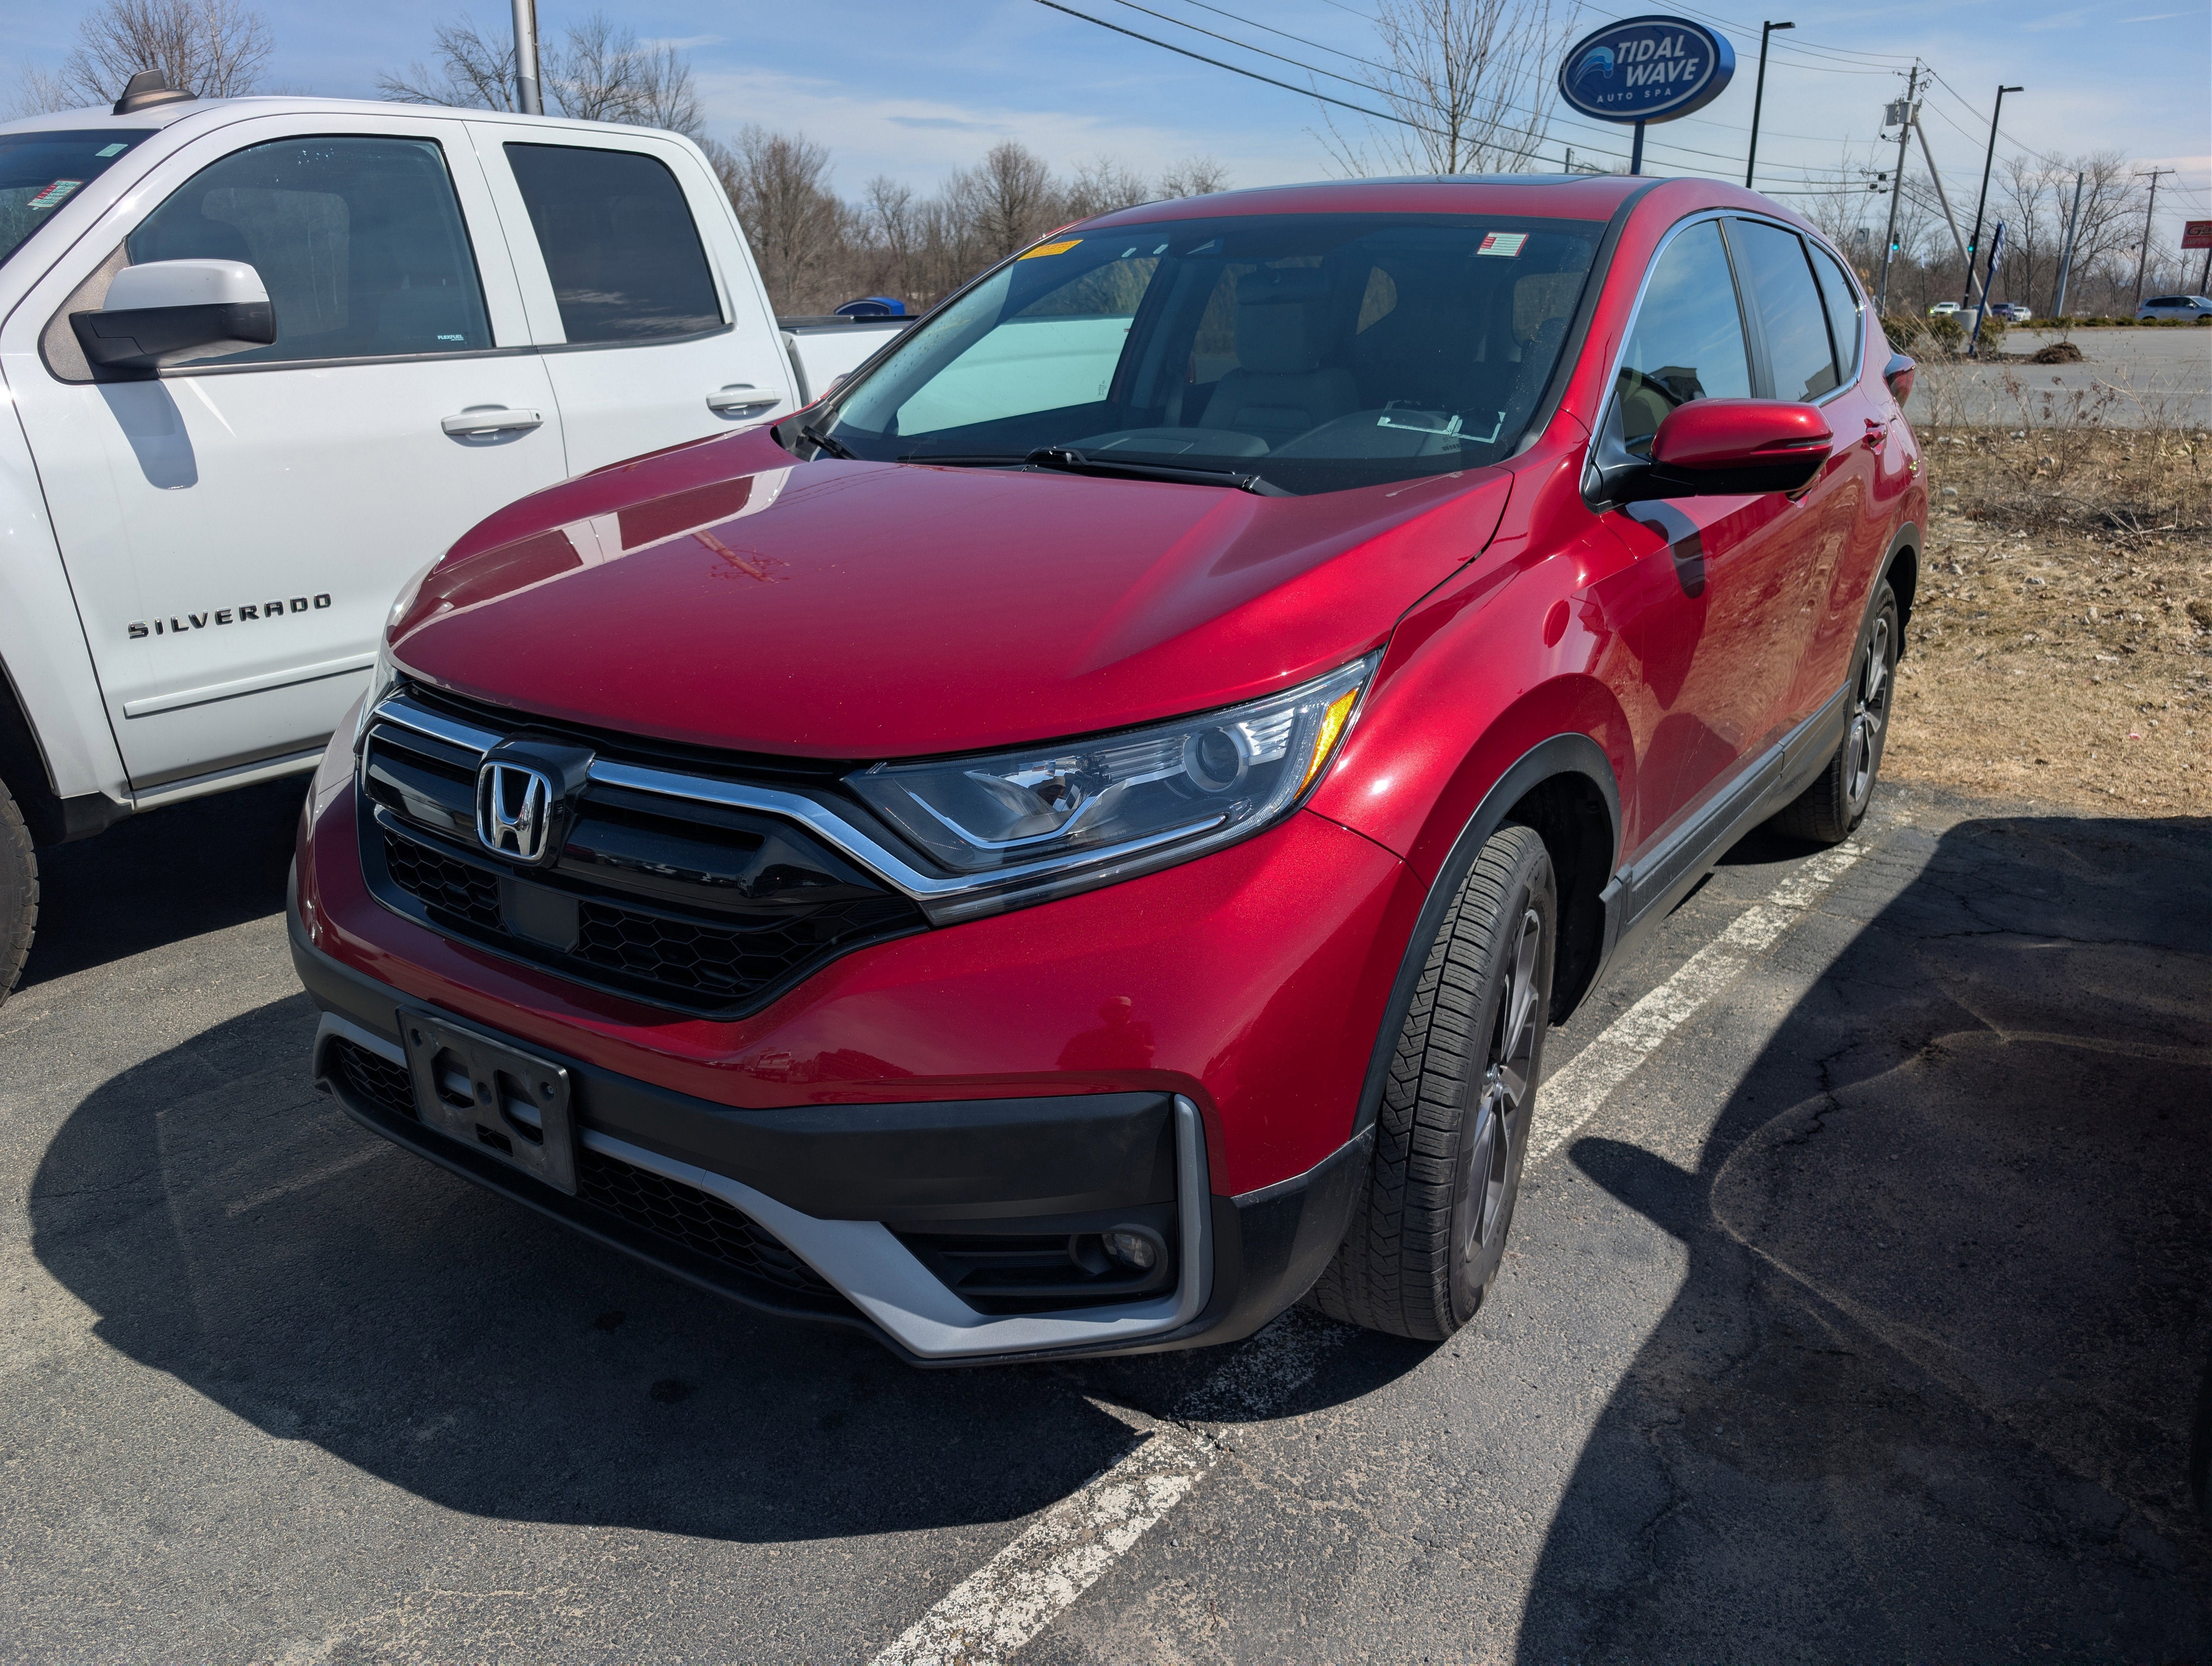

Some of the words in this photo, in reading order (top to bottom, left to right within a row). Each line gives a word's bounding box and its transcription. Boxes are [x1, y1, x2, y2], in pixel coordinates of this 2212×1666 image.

[1617, 35, 1685, 64] TIDAL
[1626, 58, 1700, 87] WAVE
[1597, 92, 1633, 103] AUTO
[1644, 88, 1671, 98] SPA
[128, 592, 331, 639] SILVERADO
